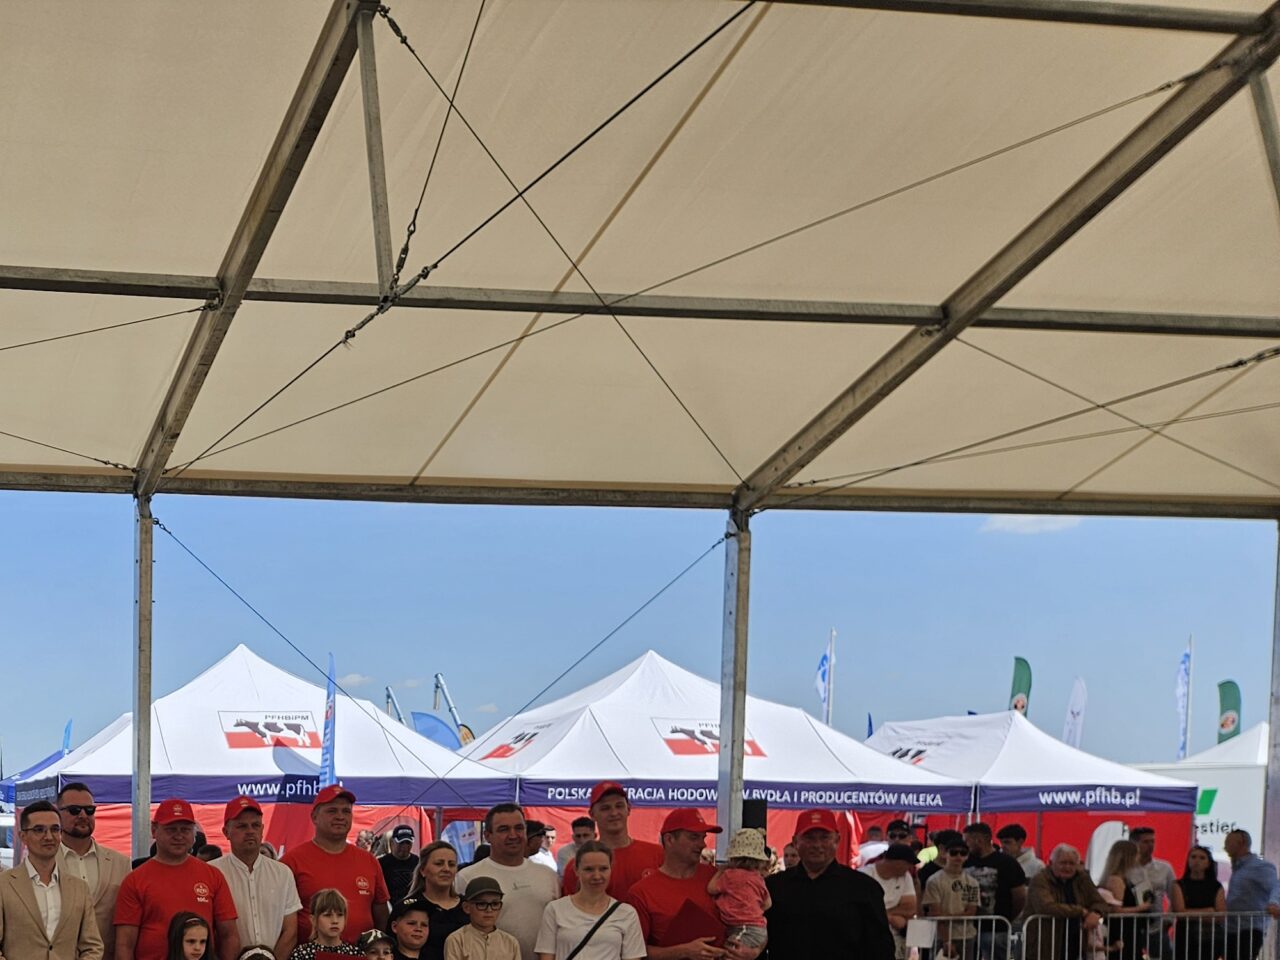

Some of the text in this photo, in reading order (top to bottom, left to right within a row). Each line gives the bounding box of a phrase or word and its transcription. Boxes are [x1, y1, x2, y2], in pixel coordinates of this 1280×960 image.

[547, 787, 593, 800] POLSKA
[793, 790, 798, 803] I
[801, 789, 897, 805] PRODUCENTÓW
[900, 792, 943, 806] MLEKA
[1039, 786, 1141, 807] www.pfhb.pl
